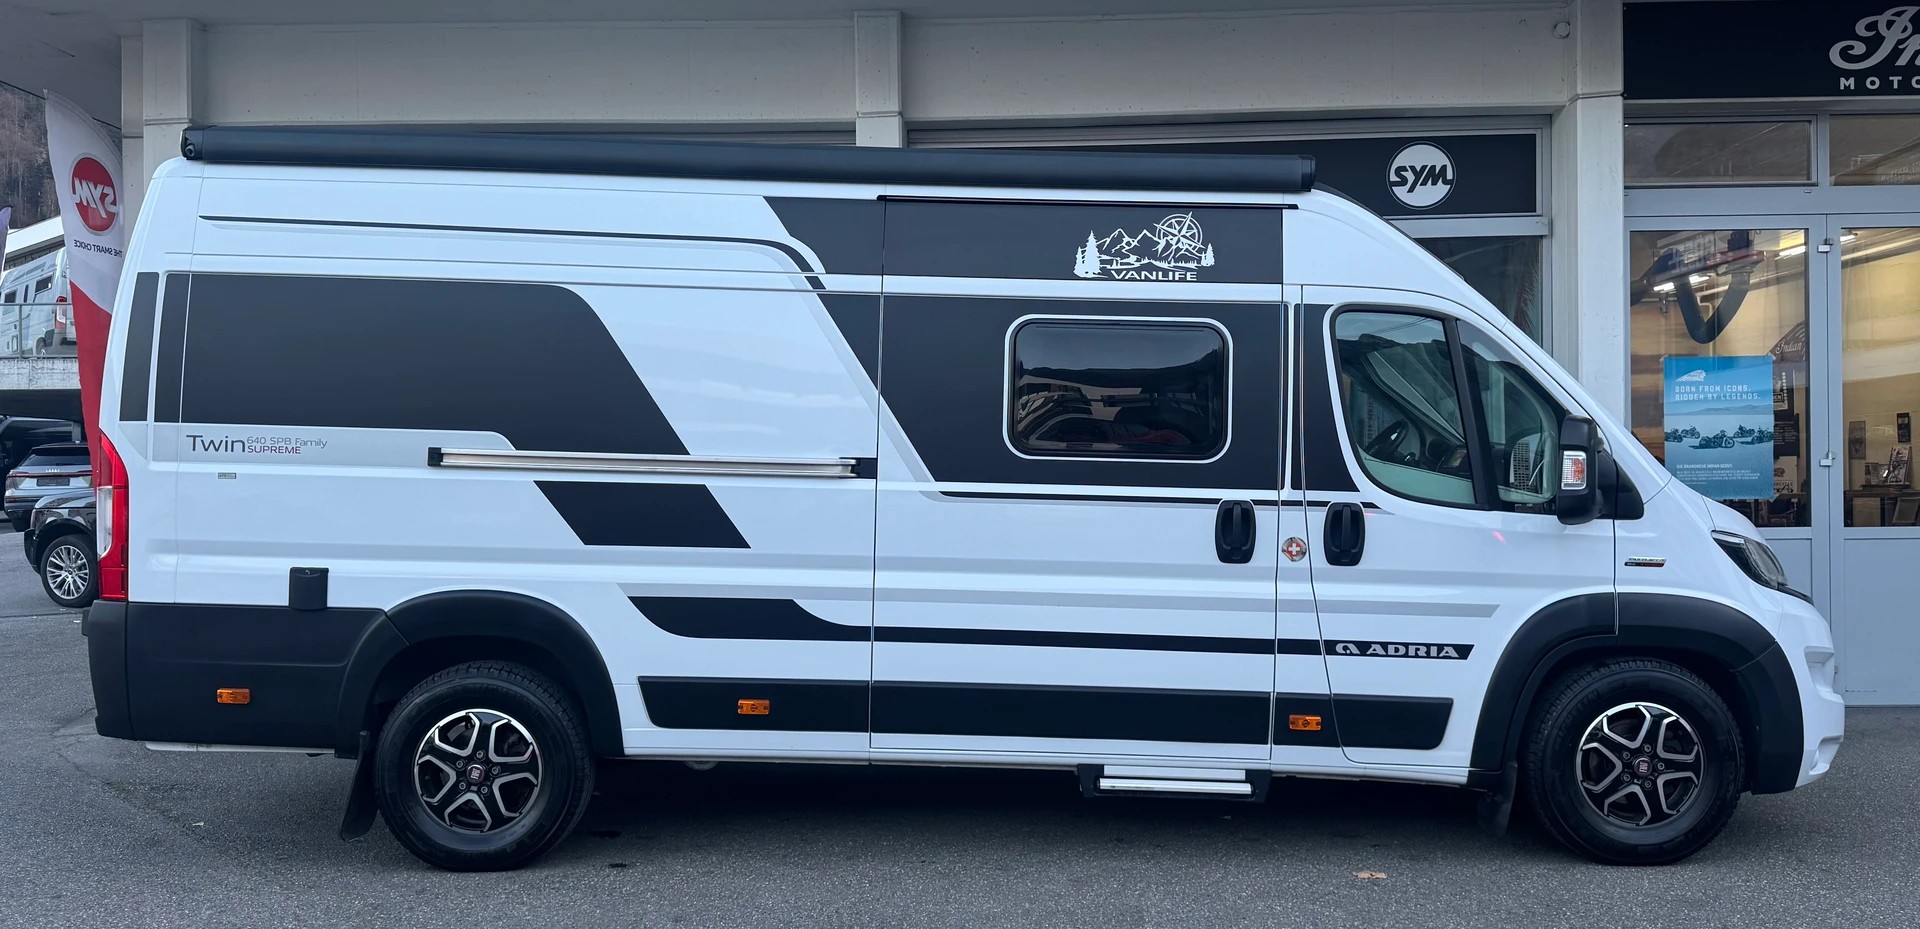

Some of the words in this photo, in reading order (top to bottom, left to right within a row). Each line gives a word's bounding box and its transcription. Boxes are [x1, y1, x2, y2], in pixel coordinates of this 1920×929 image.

[1390, 164, 1453, 194] SYM
[1110, 270, 1197, 281] VANLIFE
[1675, 385, 1697, 393] BORN
[1699, 385, 1721, 393] FROM
[1675, 393, 1705, 401] RIDDEN
[1707, 393, 1718, 401] BY
[186, 435, 246, 453] Twin
[247, 436, 267, 445] 640
[270, 437, 291, 446] SPB
[295, 438, 328, 449] Family
[247, 445, 302, 454] SUPREME
[1366, 643, 1460, 657] ADRIA
